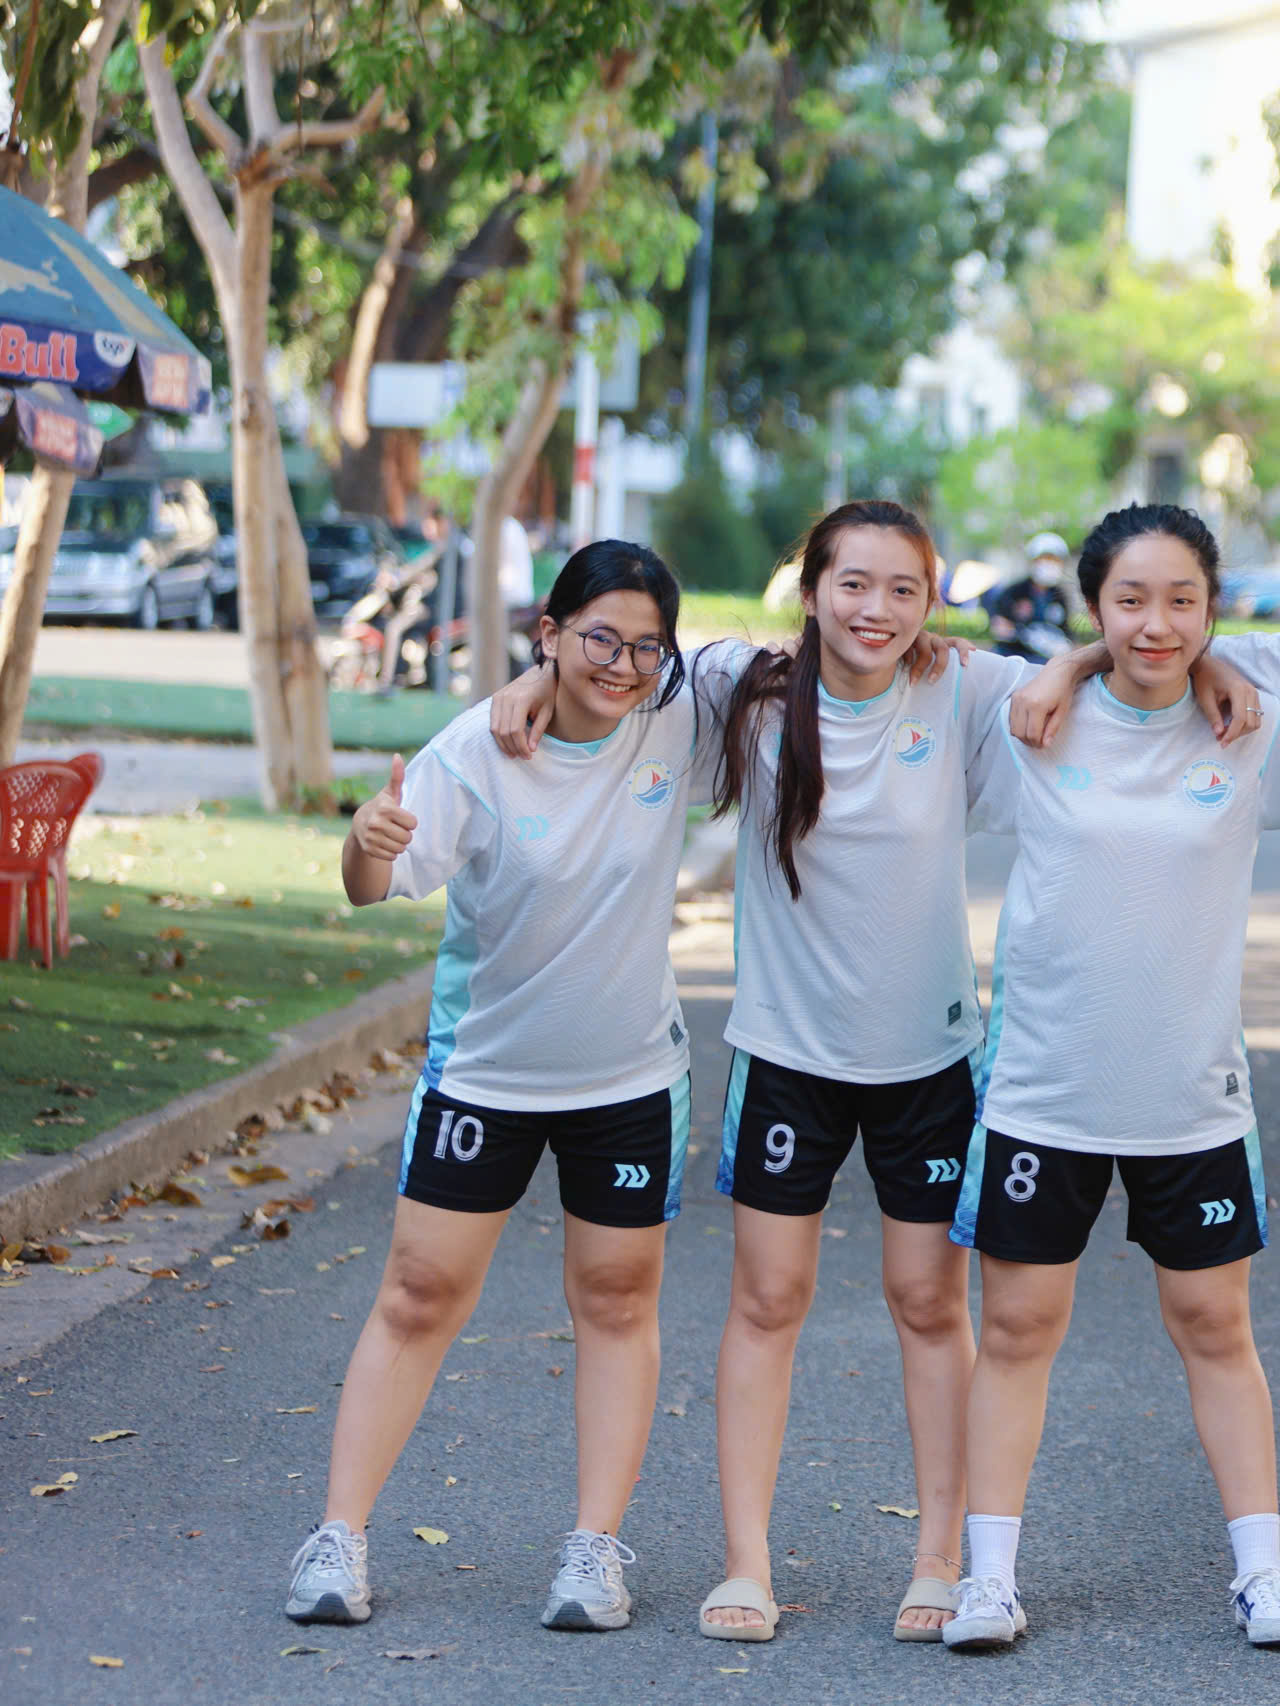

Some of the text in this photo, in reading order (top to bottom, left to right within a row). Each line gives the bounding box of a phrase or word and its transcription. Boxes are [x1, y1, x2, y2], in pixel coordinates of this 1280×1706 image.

[0, 324, 79, 381] Bull
[432, 1110, 484, 1161] 10
[764, 1124, 795, 1173] 9
[1004, 1151, 1040, 1202] 8
